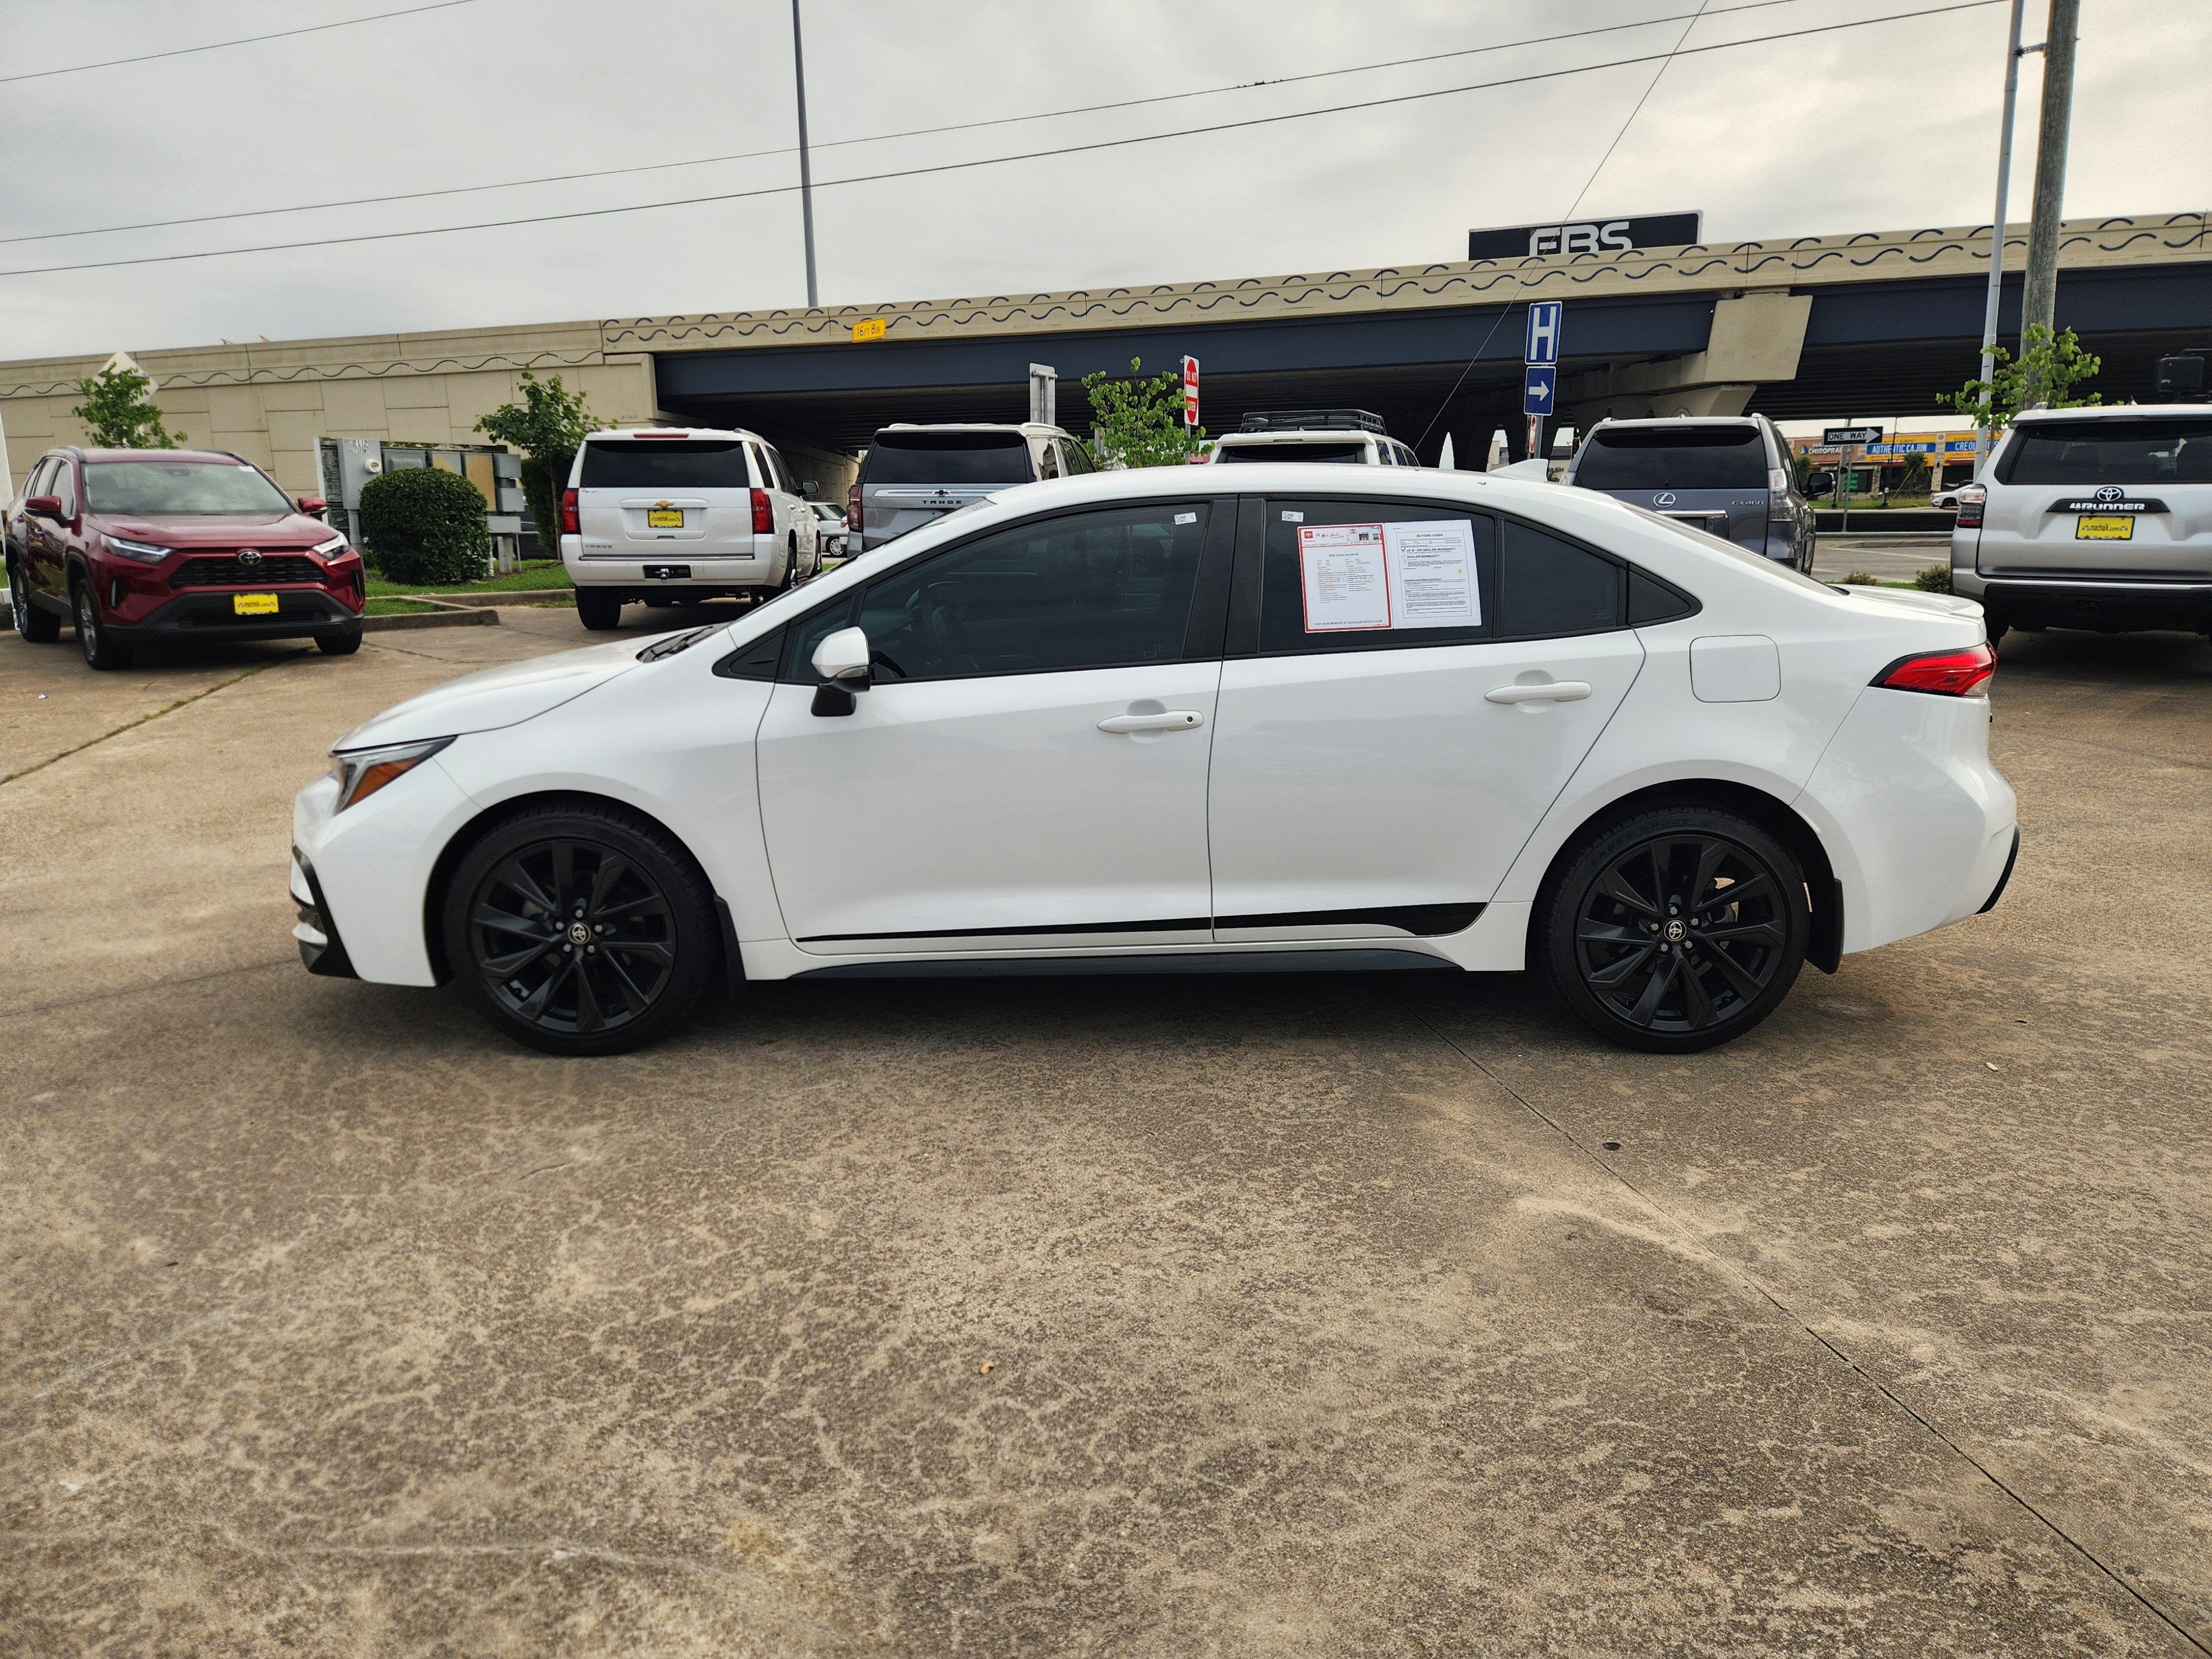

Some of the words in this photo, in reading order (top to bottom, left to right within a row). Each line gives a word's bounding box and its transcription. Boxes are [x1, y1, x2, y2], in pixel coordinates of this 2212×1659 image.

[1530, 306, 1557, 361] H
[1186, 370, 1191, 381] DO
[1906, 443, 1928, 453] CAJUN
[1955, 441, 1976, 451] CREOL
[2069, 502, 2145, 510] 4RUNNER
